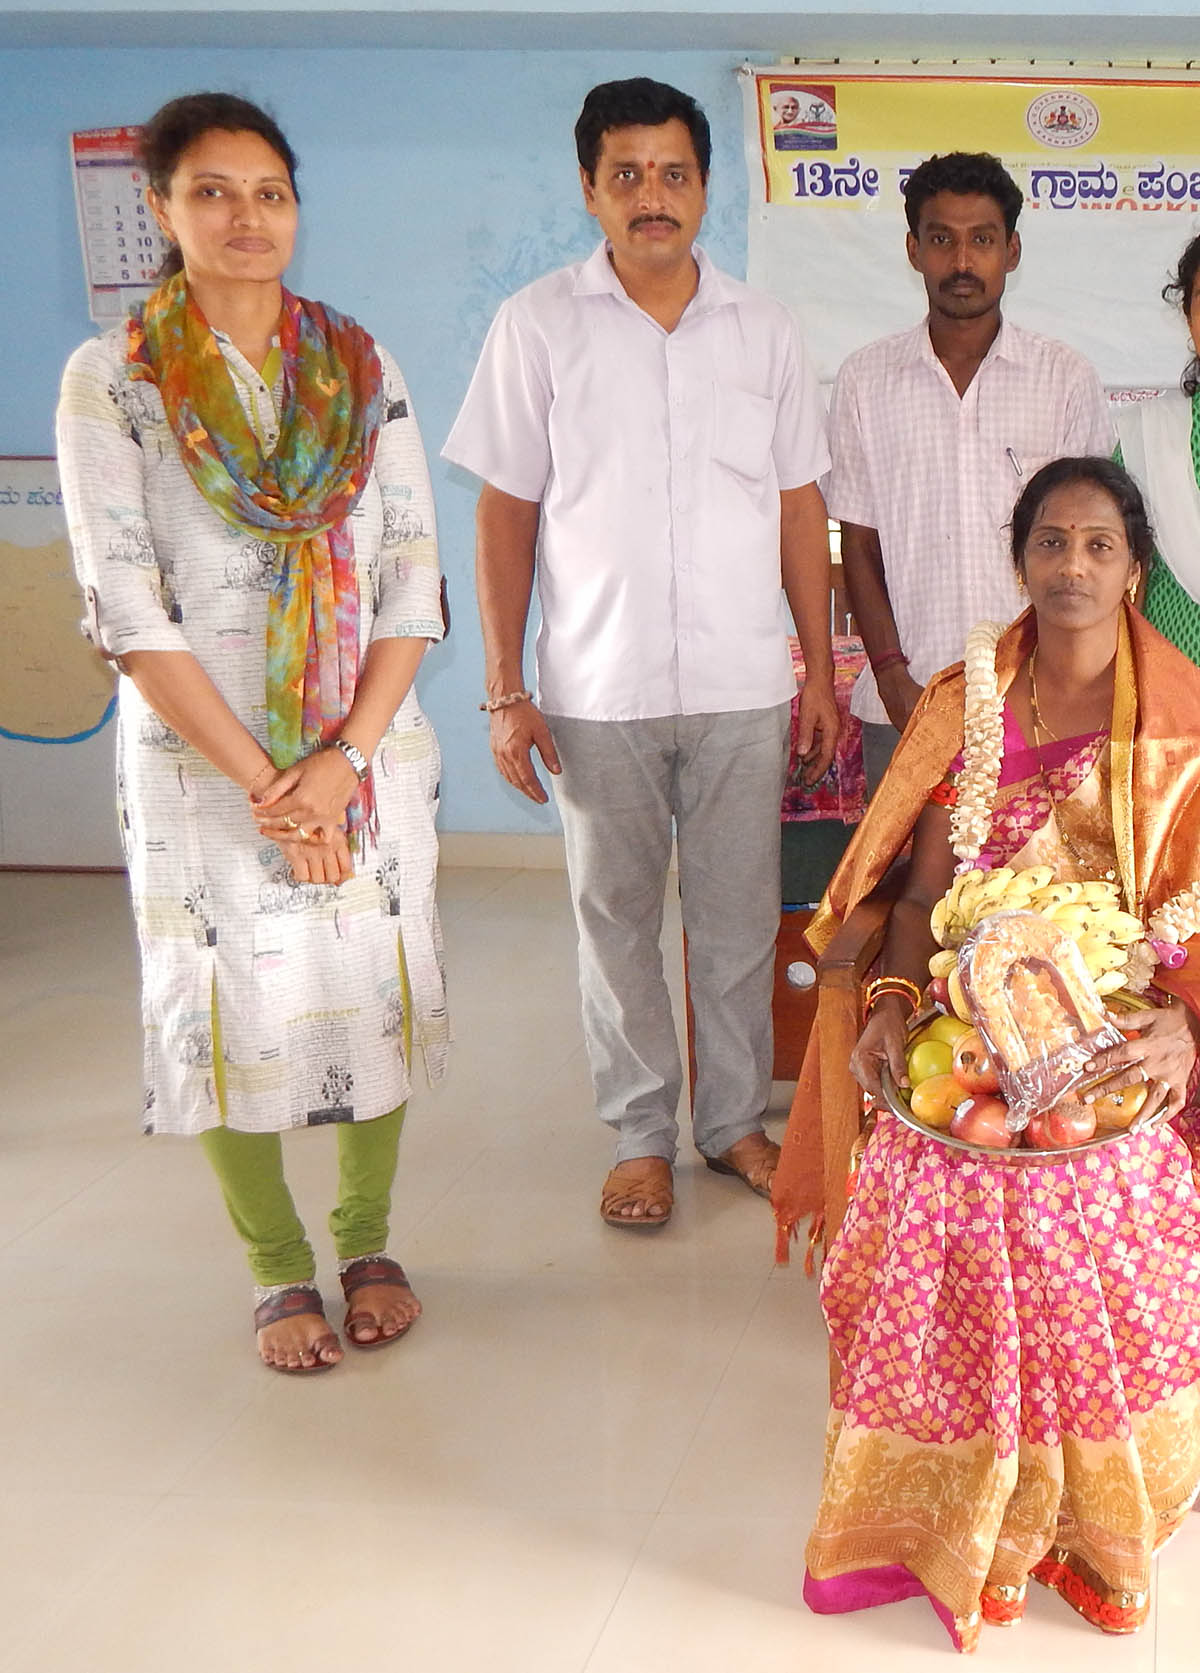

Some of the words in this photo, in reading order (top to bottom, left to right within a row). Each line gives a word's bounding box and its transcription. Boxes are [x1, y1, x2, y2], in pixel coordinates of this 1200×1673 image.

[1031, 160, 1118, 209] ಗ್ರಾಮ
[134, 188, 142, 199] 7
[115, 206, 121, 215] 1
[136, 205, 145, 215] 8
[115, 221, 124, 231] 2
[138, 220, 147, 231] 9
[117, 237, 126, 247] 3
[137, 236, 153, 248] 10
[120, 254, 128, 263] 4
[138, 253, 153, 263] 11
[121, 269, 130, 280] 5
